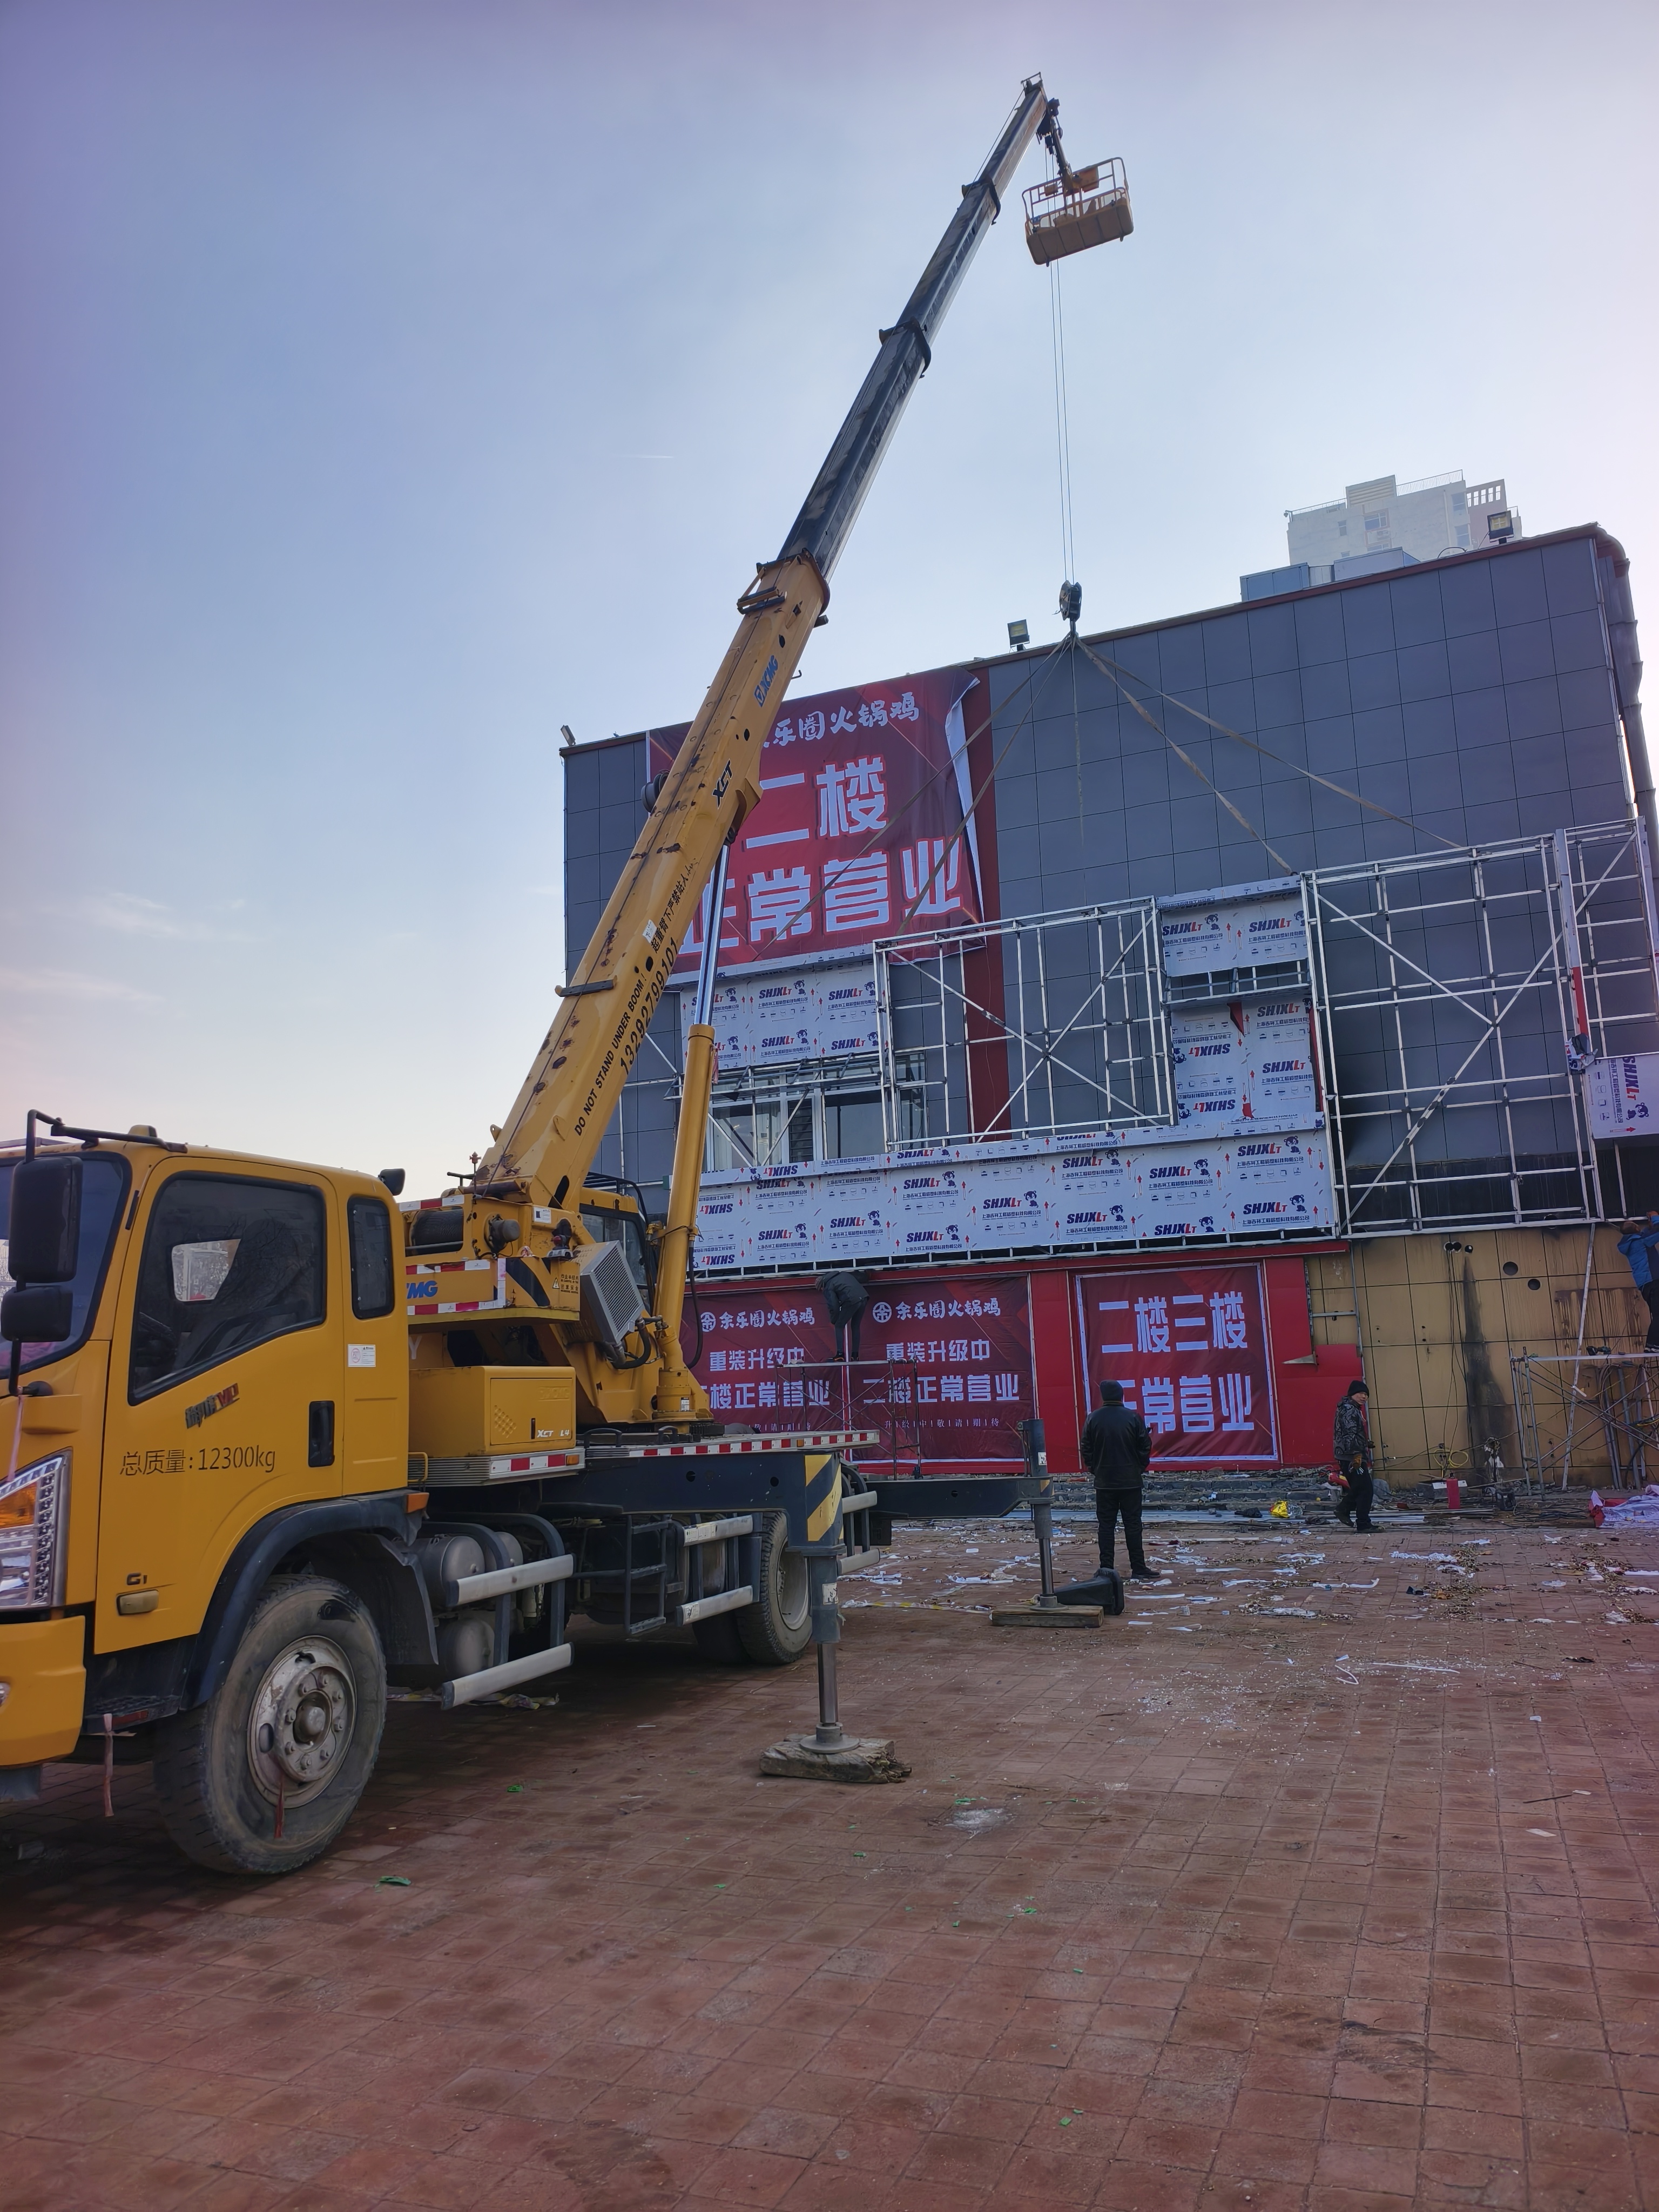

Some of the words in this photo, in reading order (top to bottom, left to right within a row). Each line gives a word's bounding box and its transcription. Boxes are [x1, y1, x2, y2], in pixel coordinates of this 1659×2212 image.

[763, 692, 919, 747] 乐圈火锅鸡
[712, 758, 733, 810] XCT
[746, 756, 887, 848] 二楼
[621, 937, 679, 1075] 13292799101
[692, 993, 724, 1006] SLT
[575, 1117, 585, 1136] DO
[583, 1088, 597, 1116] NOT
[595, 1050, 614, 1089] STAND
[611, 1011, 630, 1049] UNDER
[407, 1280, 438, 1299] MG
[719, 1307, 815, 1330] 余乐圈火锅鸡
[895, 1298, 1001, 1320] 余乐圈火锅鸡
[1099, 1291, 1247, 1353] 二楼三楼
[710, 1347, 804, 1372] 重装升级中
[886, 1339, 990, 1362] 重装升级中
[702, 1380, 830, 1409] 楼正常营业
[863, 1374, 1020, 1404] 二楼正常营业
